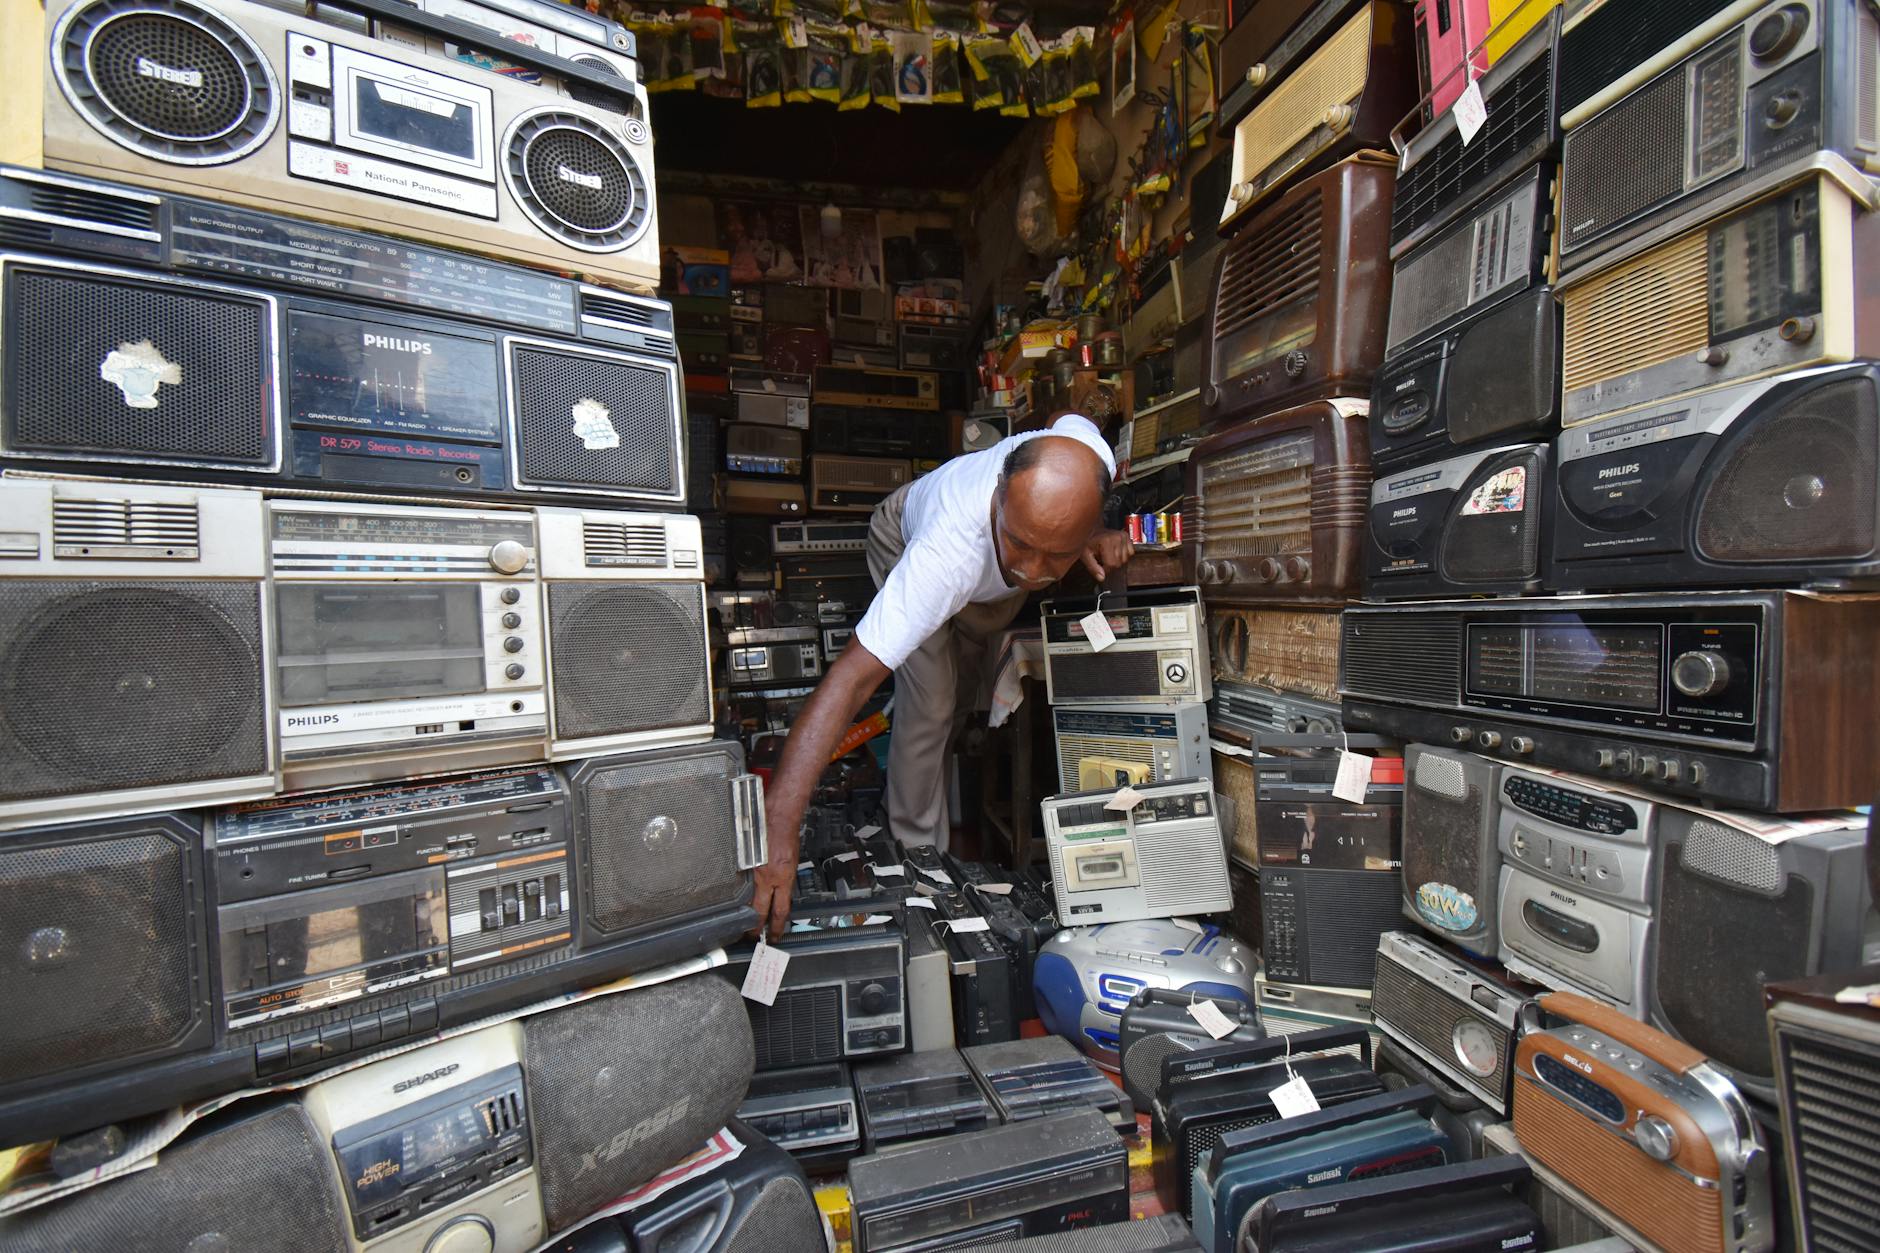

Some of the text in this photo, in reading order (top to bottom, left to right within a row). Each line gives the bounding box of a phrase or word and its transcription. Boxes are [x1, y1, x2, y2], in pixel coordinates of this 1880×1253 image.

[364, 170, 462, 200] National Panasonic
[189, 215, 264, 235] MUSIC POWER OUTPUT
[1573, 217, 1595, 234] PHILIPS
[289, 240, 320, 252] MEDIUM
[320, 246, 340, 256] WAVE
[334, 238, 380, 252] MODULATION
[290, 259, 315, 269] SHORT
[316, 264, 337, 274] WAVE
[290, 274, 316, 284] SHORT
[316, 279, 337, 288] WAVE
[363, 333, 432, 355] PHILIPS
[308, 412, 337, 422] GRAPHIC
[337, 415, 372, 425] EQUALIZER
[320, 436, 481, 461] DR 579 Stereo Radio Recorder
[1598, 463, 1640, 480] PHILIPS
[1393, 507, 1417, 518] PHILIPS
[287, 714, 340, 727] PHILIPS
[233, 845, 259, 855] PHONES
[288, 872, 327, 884] FINE TUNING
[1550, 890, 1577, 906] PHILIPS
[259, 995, 282, 1005] AUTO
[1177, 1035, 1200, 1043] PHILIPS
[1184, 1060, 1214, 1072] Santosh
[392, 1063, 460, 1094] SHARP
[571, 1095, 692, 1181] X-BASS
[363, 1158, 392, 1176] HIGH
[357, 1164, 400, 1189] POWER
[1307, 1167, 1341, 1184] Santosh
[1304, 1205, 1336, 1218] Santosh
[1501, 1235, 1534, 1250] Santosh
